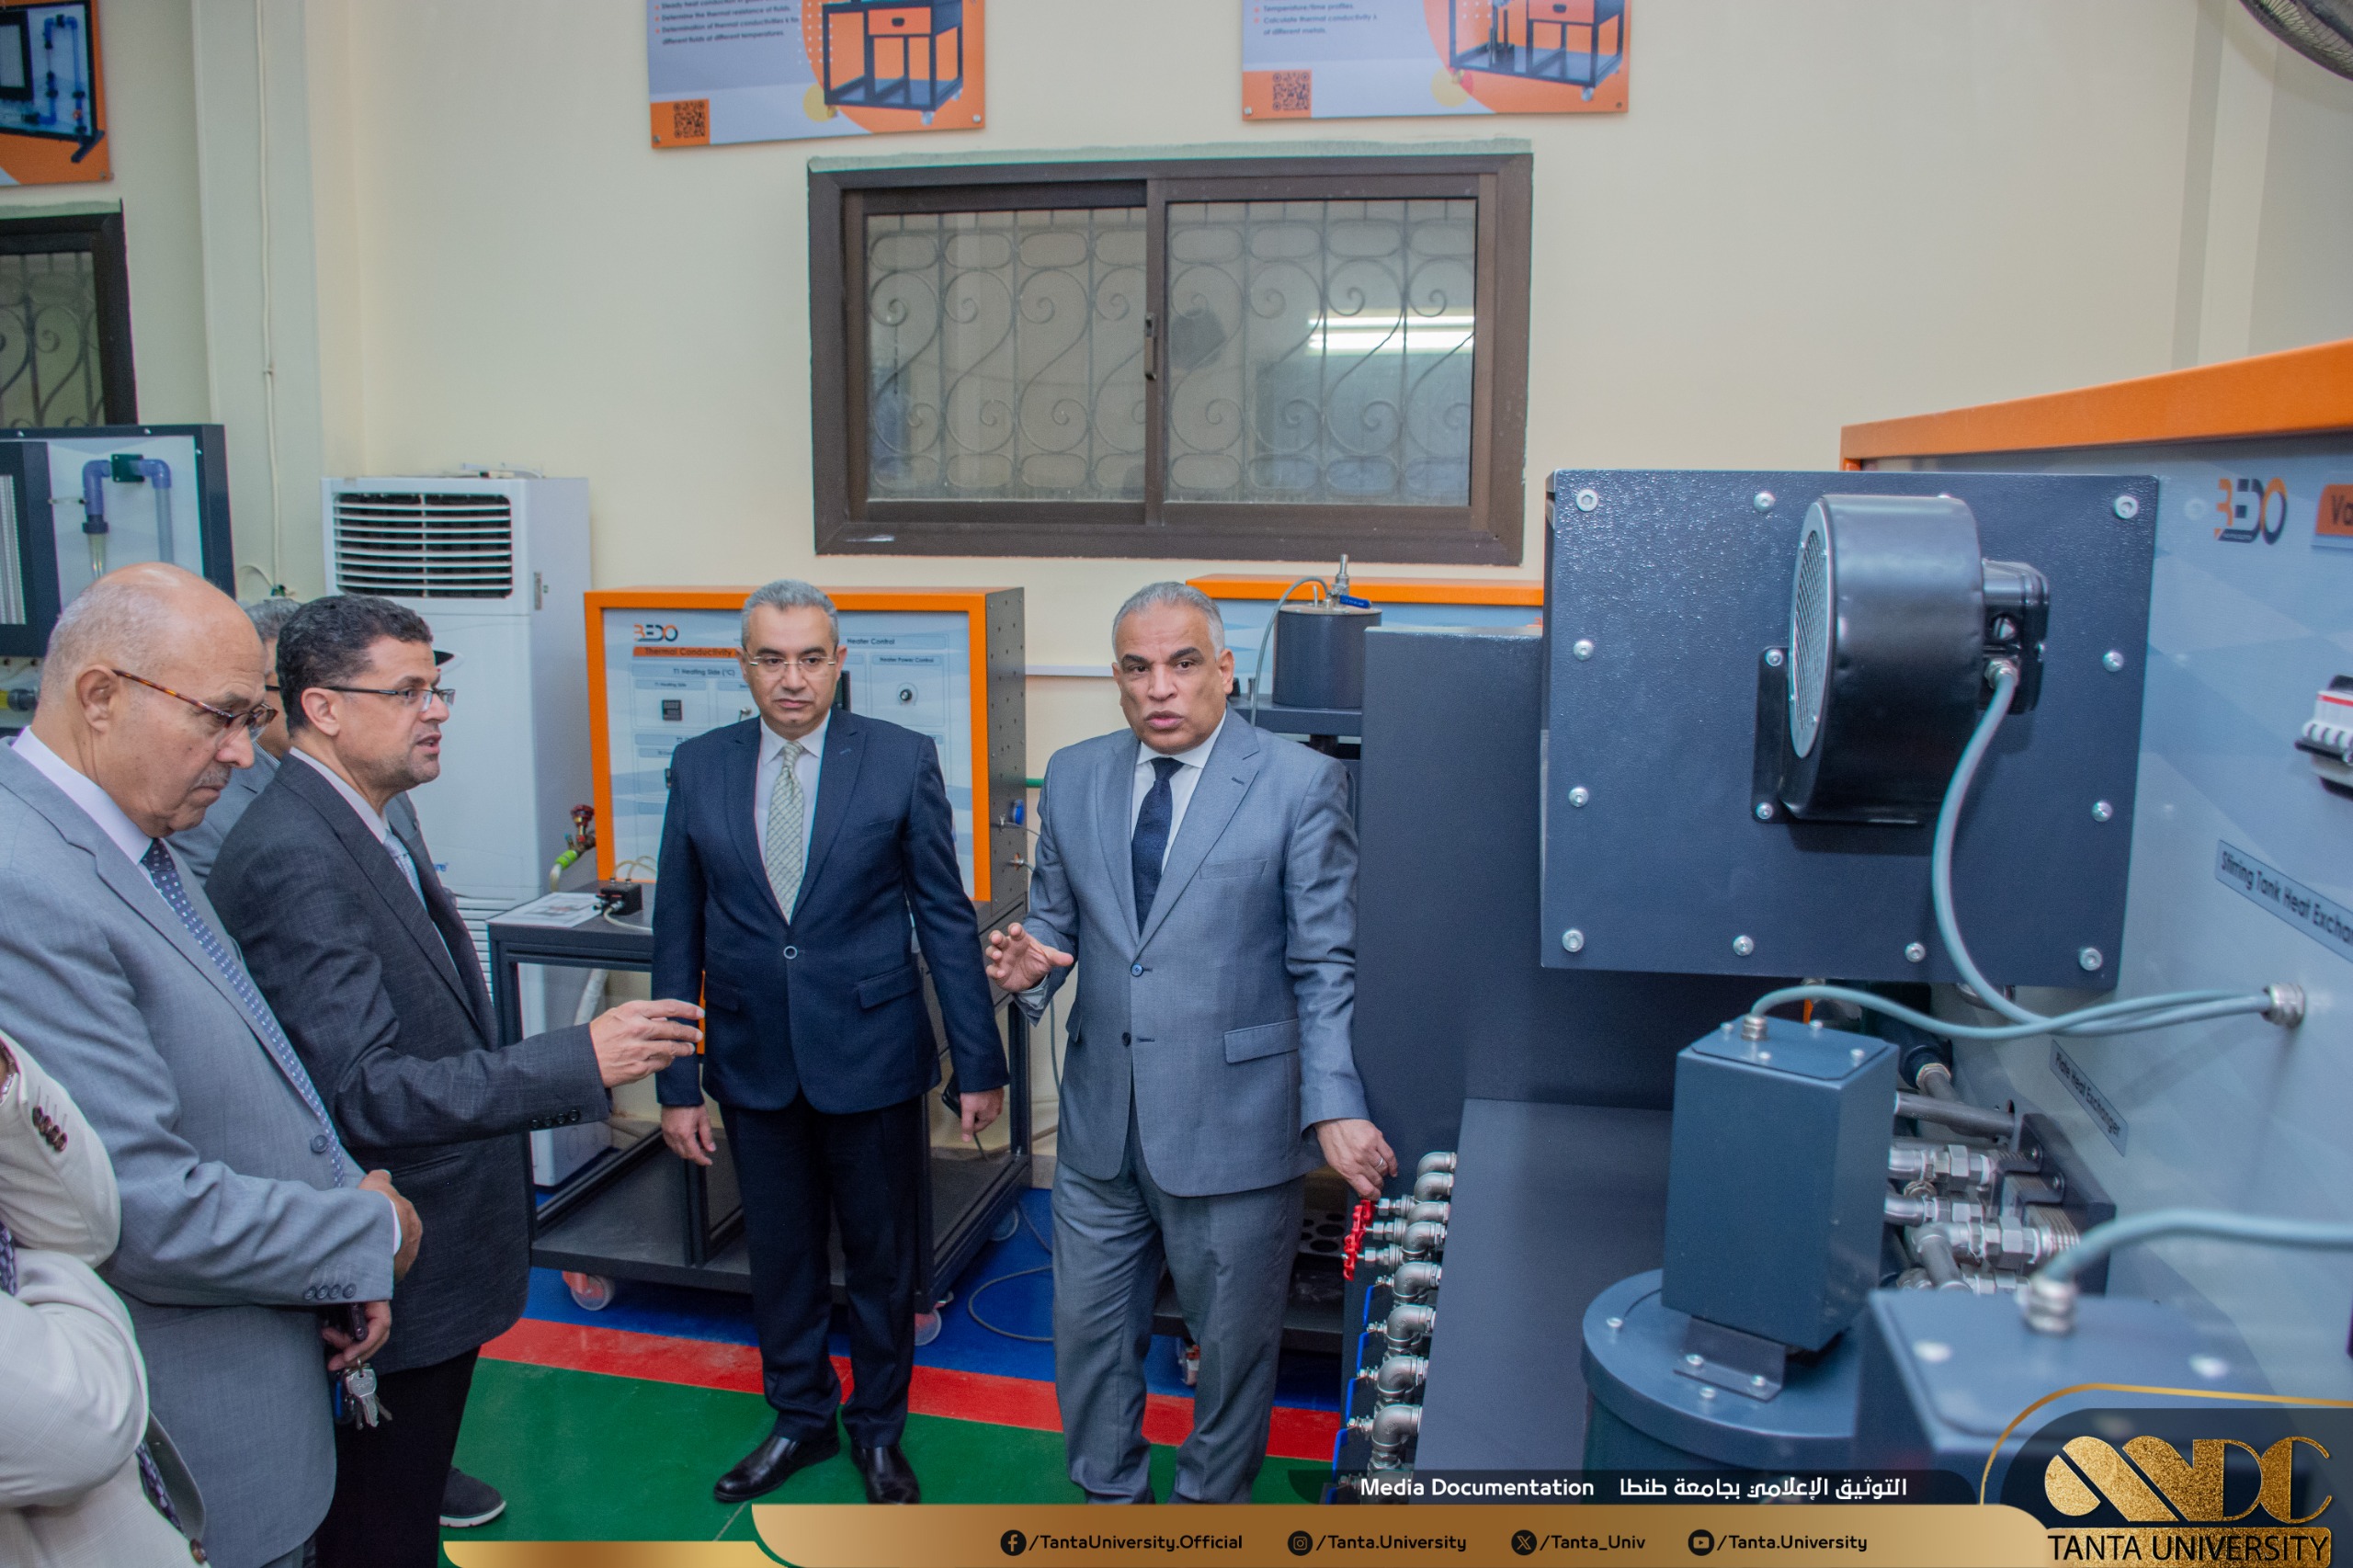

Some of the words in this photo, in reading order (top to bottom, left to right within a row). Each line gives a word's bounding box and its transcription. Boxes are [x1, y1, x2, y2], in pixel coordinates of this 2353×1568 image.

[662, 13, 693, 21] Determine
[1328, 14, 1370, 22] conductivity
[662, 24, 705, 33] Determination
[662, 37, 688, 45] different
[645, 647, 676, 655] Thermal
[680, 647, 732, 657] Conductivity
[2222, 850, 2254, 892] Stirring
[2256, 869, 2280, 903] Tank
[2283, 885, 2311, 920] Heat
[2313, 902, 2353, 946] Excha
[2056, 1051, 2071, 1079] Plate
[2071, 1070, 2086, 1096] Heat
[2086, 1086, 2120, 1137] Exchanger
